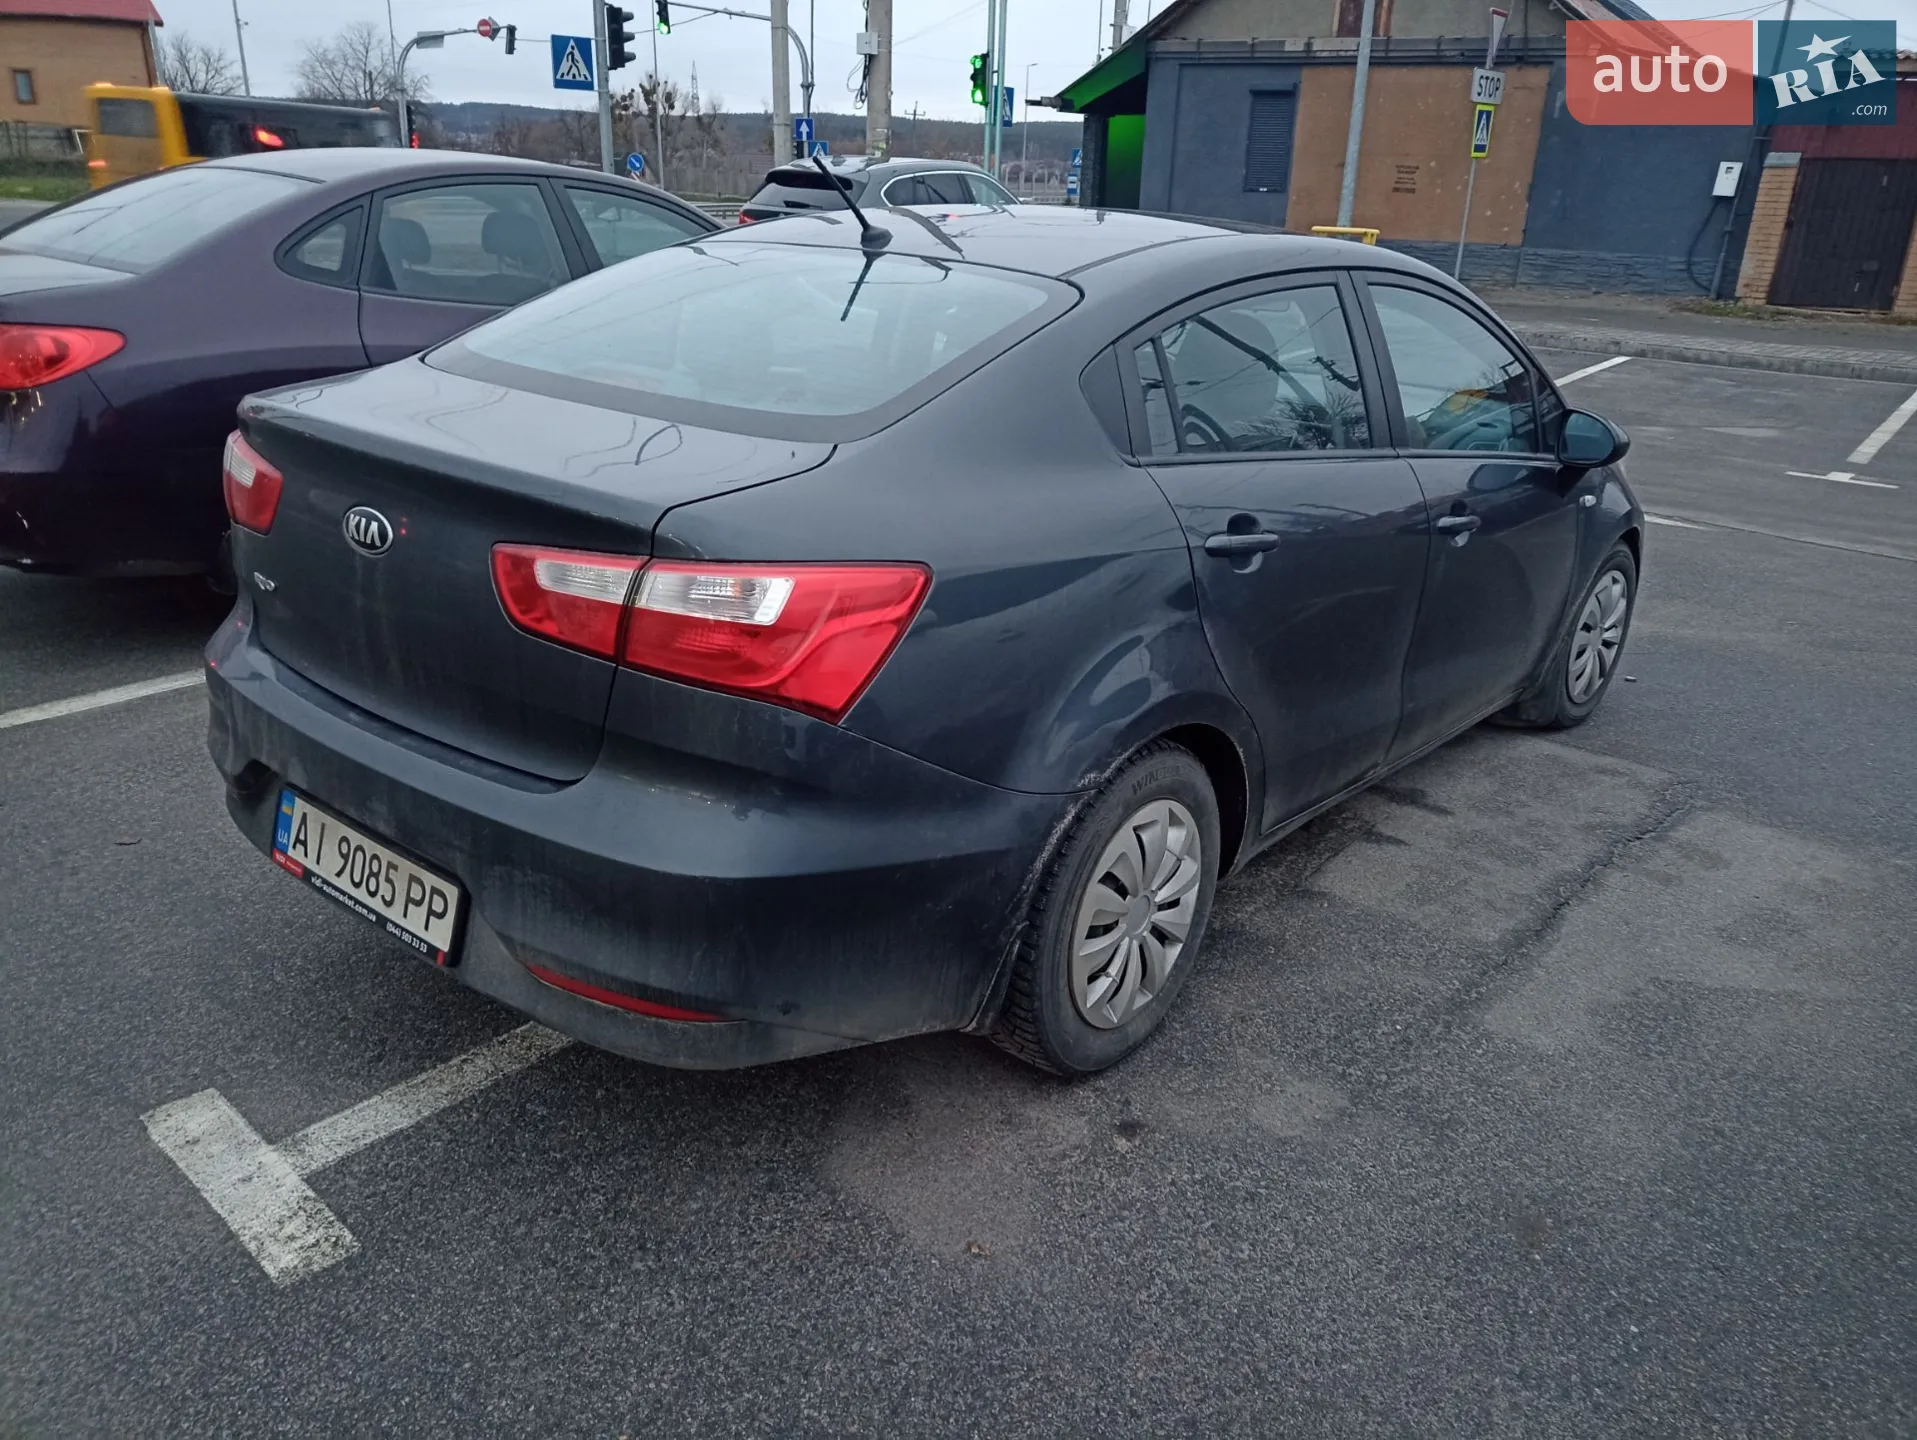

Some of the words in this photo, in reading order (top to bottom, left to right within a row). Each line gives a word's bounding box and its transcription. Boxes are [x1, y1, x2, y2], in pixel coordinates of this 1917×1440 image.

[1477, 75, 1501, 98] STOP
[348, 513, 382, 547] KIA
[277, 831, 289, 846] UA
[292, 811, 326, 865] AI
[334, 835, 400, 909] 9085
[402, 872, 449, 932] PP
[386, 921, 402, 938] (044)
[401, 931, 412, 944] 503
[411, 937, 420, 948] 33
